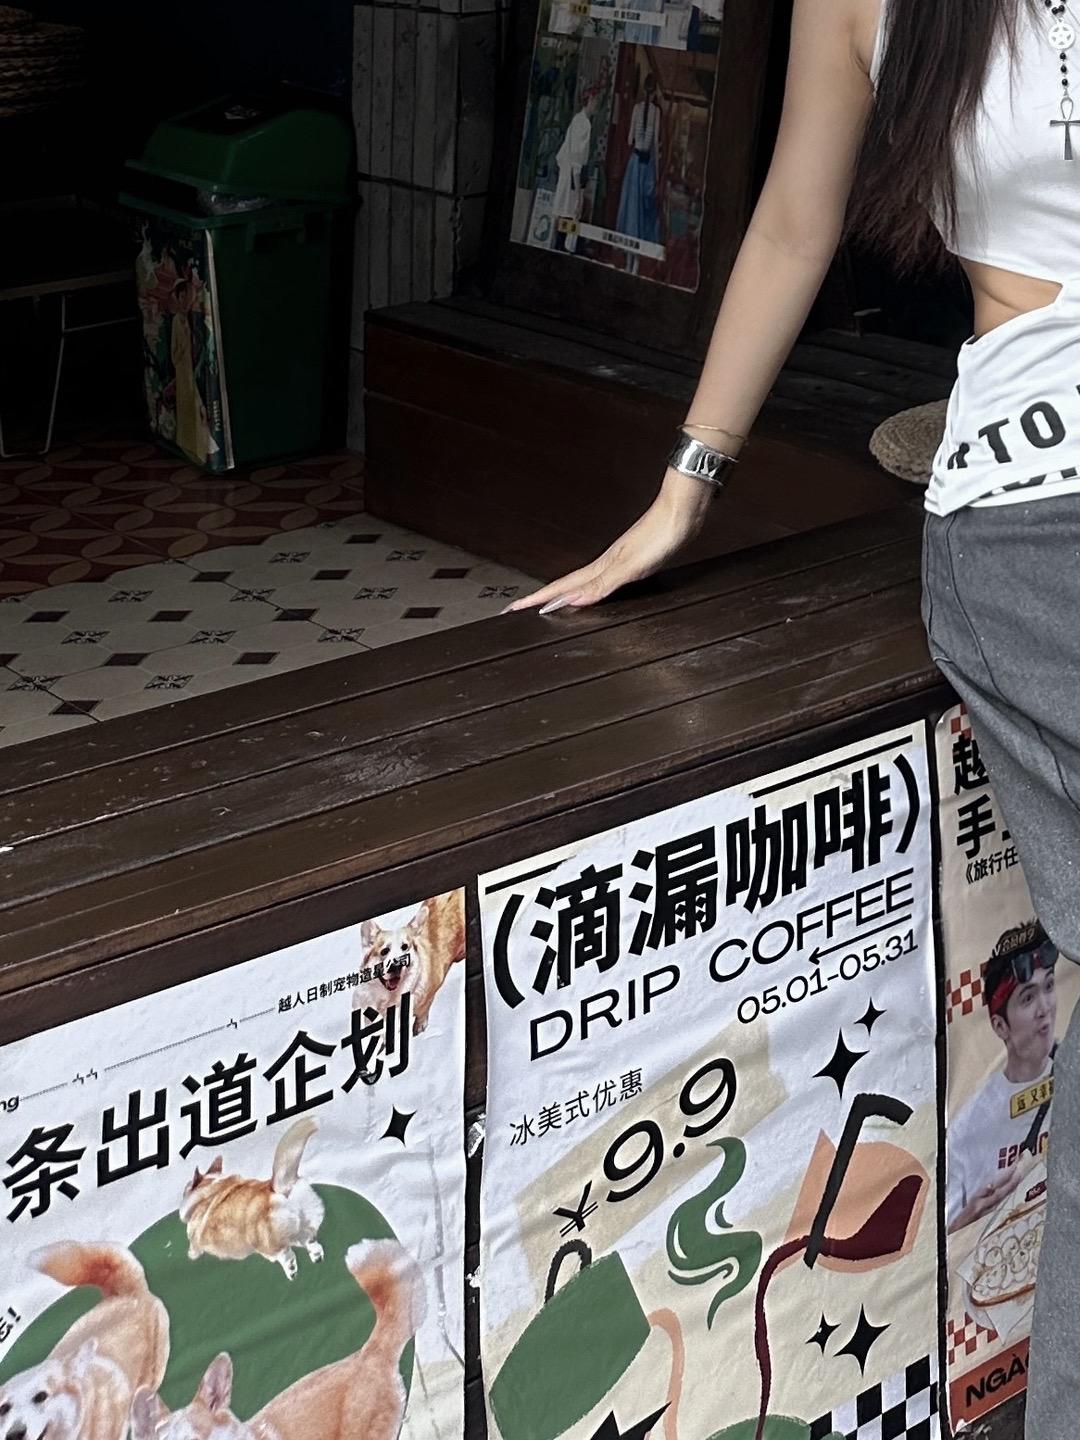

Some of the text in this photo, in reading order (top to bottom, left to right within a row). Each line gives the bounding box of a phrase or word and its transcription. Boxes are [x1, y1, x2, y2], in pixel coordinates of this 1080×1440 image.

[978, 400, 1066, 465] TO
[489, 753, 921, 1011] (滴漏咖啡)
[278, 953, 411, 1014] 越人日制宠物造星公司
[529, 868, 915, 1061] DRIP COFFEE
[736, 927, 919, 1025] 05.01-05.31
[2, 991, 413, 1225] 条出道企划
[508, 1067, 644, 1146] 冰美式优惠
[552, 1057, 737, 1233] ¥9.9
[966, 1354, 1029, 1408] NGÀ
